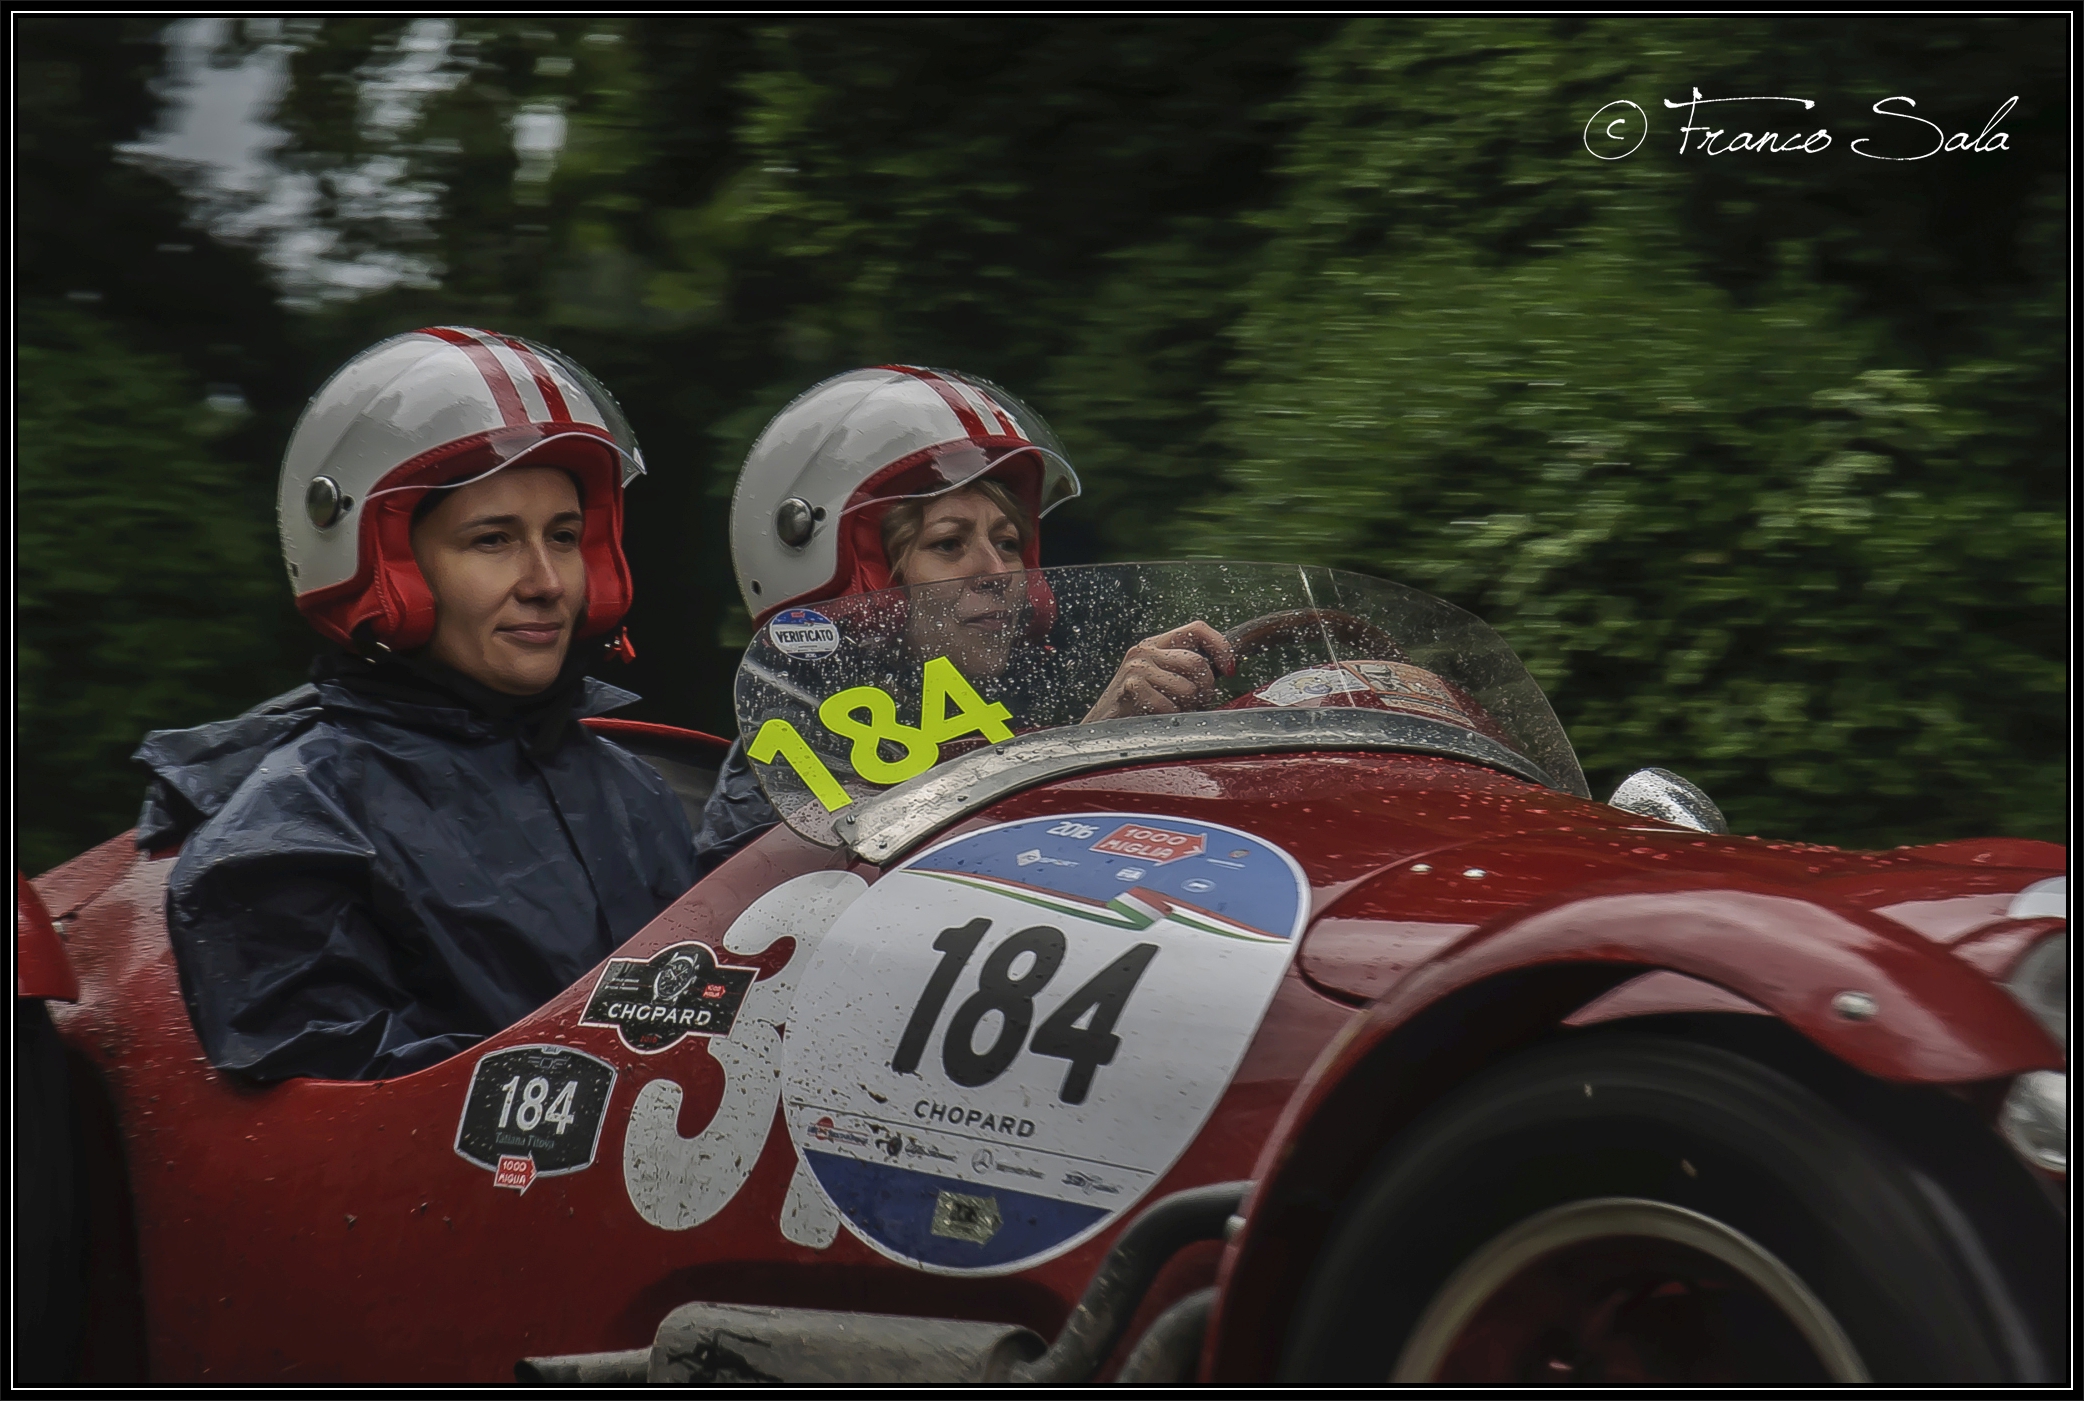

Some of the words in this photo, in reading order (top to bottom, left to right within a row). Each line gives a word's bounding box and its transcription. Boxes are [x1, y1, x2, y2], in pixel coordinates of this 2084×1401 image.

[775, 629, 834, 643] VERIFICATO
[747, 656, 1015, 812] 184
[1046, 821, 1100, 840] 2016
[1123, 828, 1188, 846] 1000
[1100, 839, 1174, 859] MIGLIA
[607, 1003, 712, 1026] CHOPARD
[890, 917, 1162, 1105] 184
[498, 1075, 578, 1135] 184
[913, 1100, 1036, 1138] CHOPARD
[503, 1160, 527, 1172] 1000
